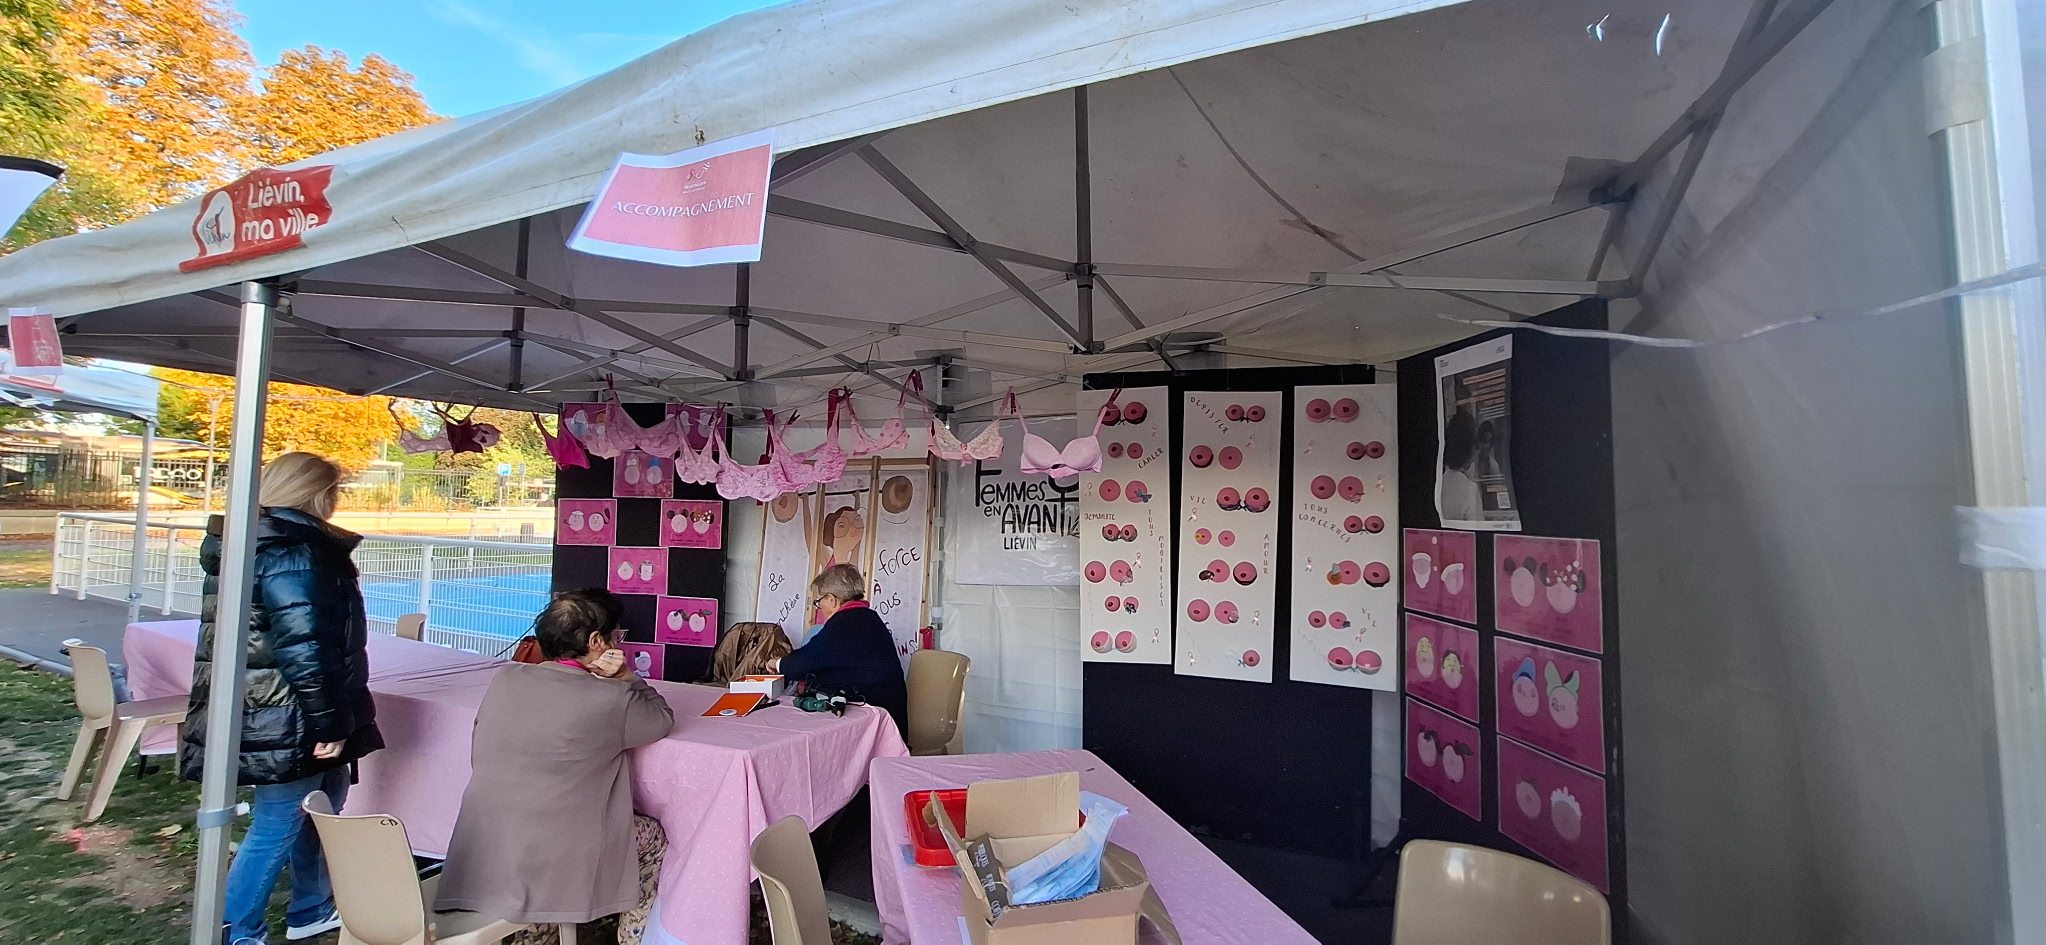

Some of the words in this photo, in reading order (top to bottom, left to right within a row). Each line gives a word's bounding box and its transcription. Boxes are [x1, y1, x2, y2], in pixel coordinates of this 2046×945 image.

[248, 177, 304, 209] Liévin,
[611, 192, 755, 217] ACCOMPAGNEMENT
[242, 219, 275, 242] ma
[278, 207, 320, 237] ville
[1003, 535, 1037, 550] LIÉVIN
[873, 579, 882, 596] À
